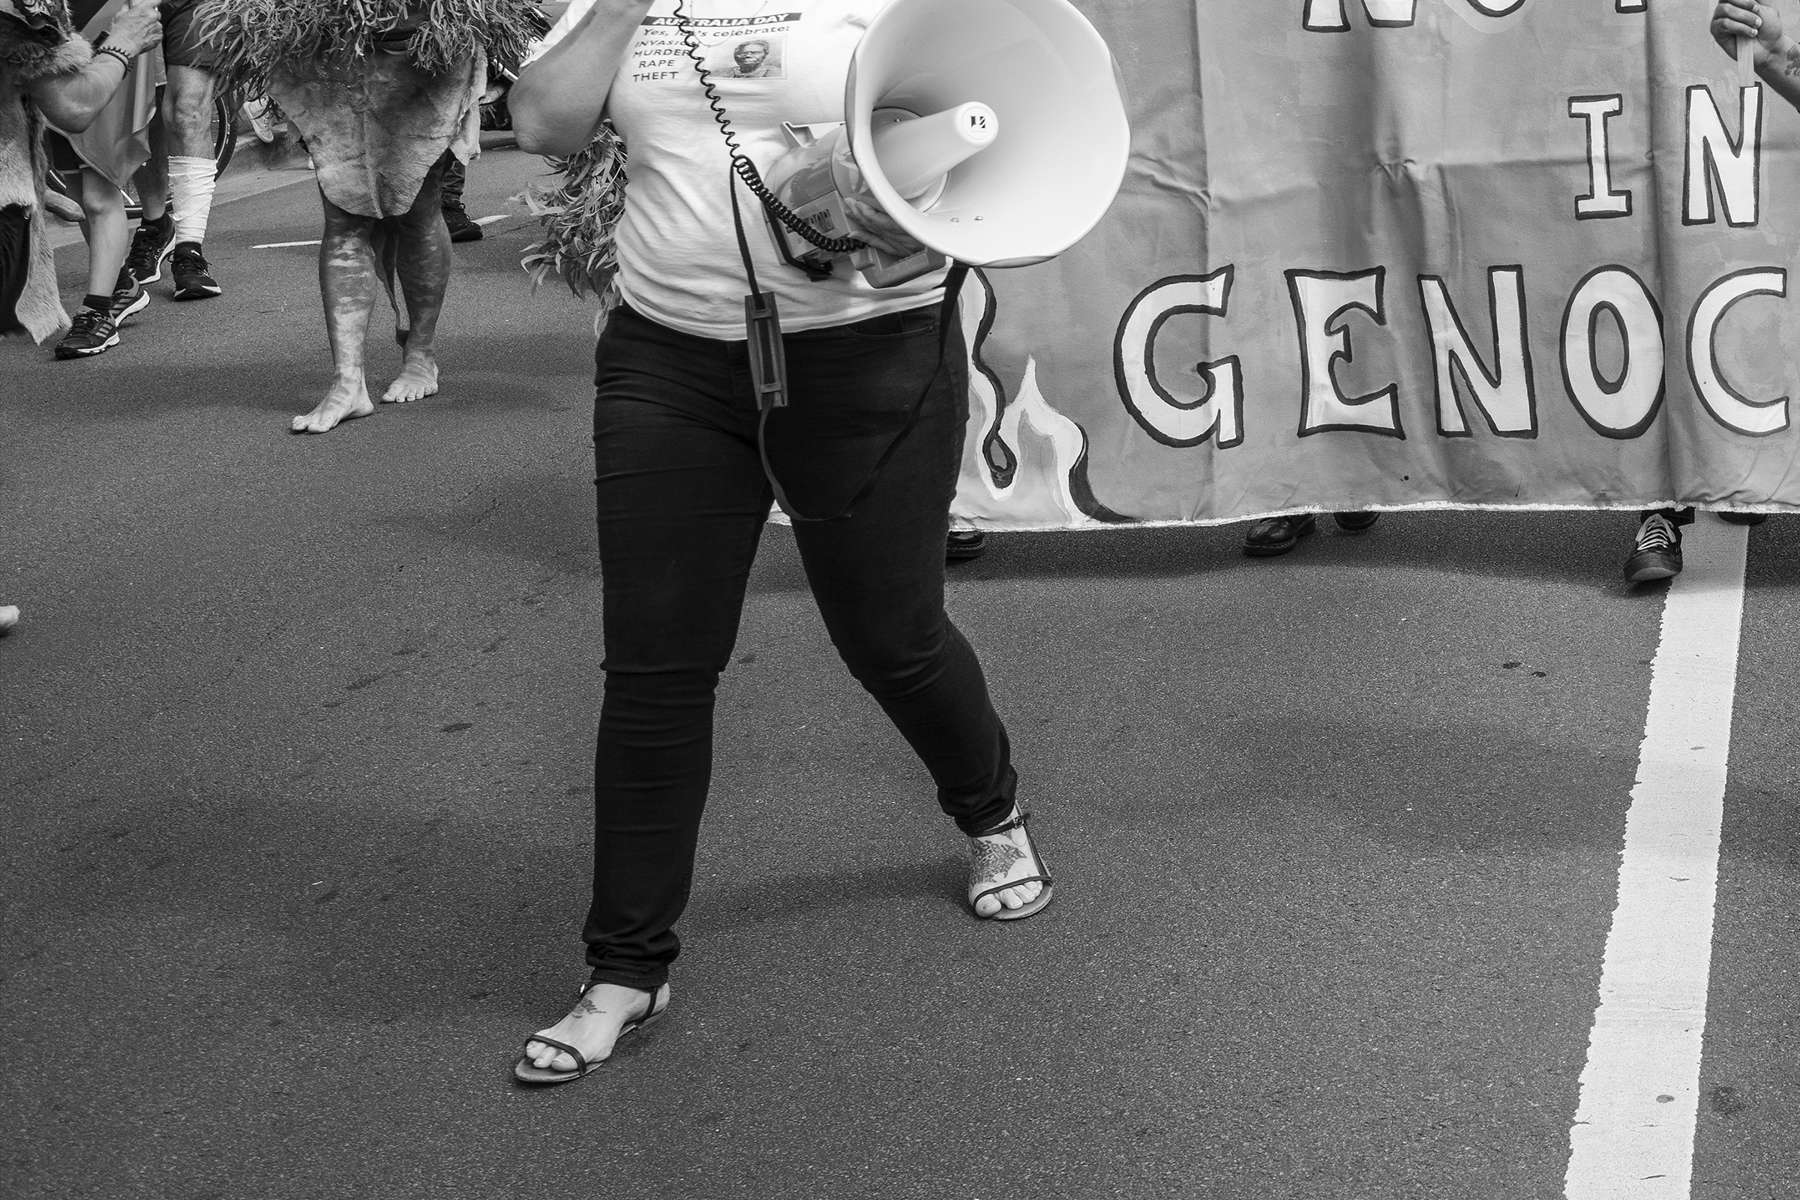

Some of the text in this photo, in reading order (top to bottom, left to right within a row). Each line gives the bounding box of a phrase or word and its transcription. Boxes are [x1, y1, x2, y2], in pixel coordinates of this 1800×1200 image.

[653, 14, 790, 26] AUTRALIA DAY
[639, 60, 675, 68] RAPE
[633, 72, 679, 82] THEFT
[1568, 83, 1763, 227] IN
